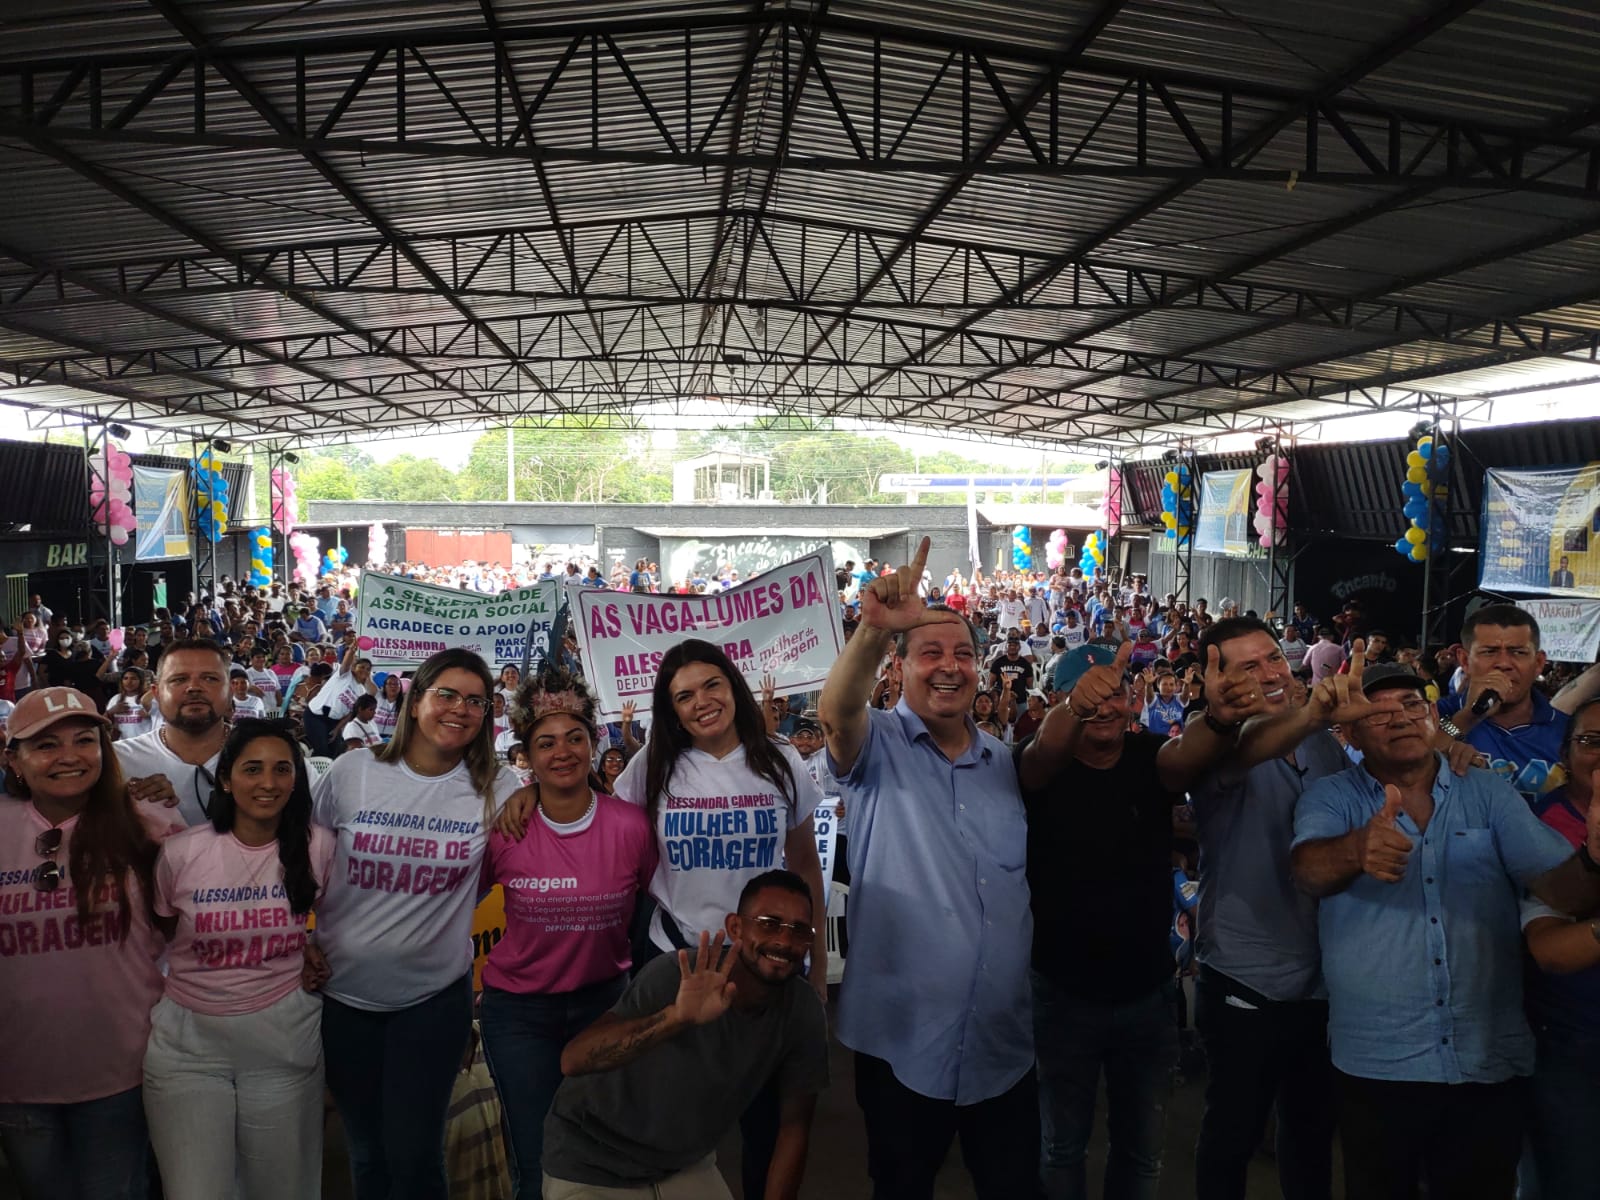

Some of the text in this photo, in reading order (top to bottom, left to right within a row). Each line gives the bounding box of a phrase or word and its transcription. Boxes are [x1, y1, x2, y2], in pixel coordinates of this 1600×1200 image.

[47, 542, 88, 567] BAR
[383, 585, 396, 596] A
[520, 588, 542, 600] DE
[1330, 570, 1398, 598] Encanto
[485, 601, 550, 619] SOCIAL
[591, 571, 824, 639] AS VAGA-LUMES DA
[367, 617, 551, 636] AGRADECE O APOIO DE
[372, 637, 447, 651] ALESSANDRA
[759, 627, 815, 662] mulher de
[762, 634, 819, 674] coragem
[614, 639, 755, 677] ALESRA
[616, 676, 655, 691] DEPUT
[44, 693, 84, 713] LA
[667, 795, 729, 810] ALESSANDRA
[353, 810, 425, 831] ALESSANDRA
[665, 808, 779, 837] MULHER DE
[352, 831, 471, 860] MULHER DE
[666, 837, 778, 871] CORAGEM
[347, 856, 472, 896] CORAGEM
[508, 877, 578, 893] coragem
[192, 885, 268, 904] ALESSANDRA
[195, 907, 288, 933] MULHER
